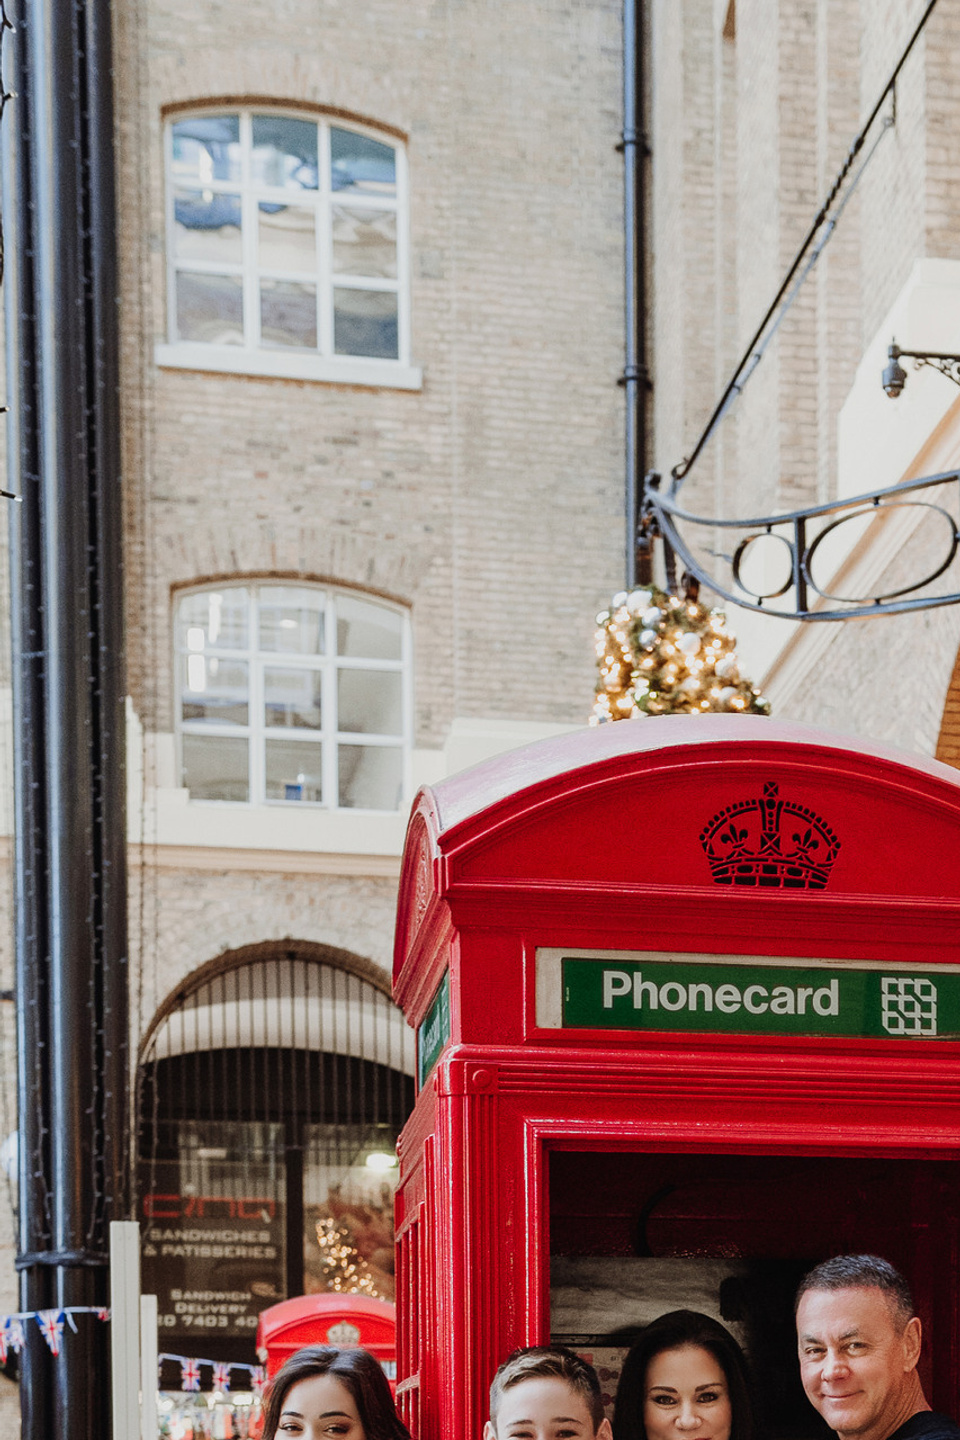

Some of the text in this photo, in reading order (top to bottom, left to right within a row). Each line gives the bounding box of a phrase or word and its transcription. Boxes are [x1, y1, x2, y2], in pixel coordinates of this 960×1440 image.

[603, 970, 839, 1016] Phonecard
[150, 1228, 270, 1243] SANDWICHES
[162, 1243, 276, 1258] PATISSERIES
[181, 1314, 228, 1327] 7403
